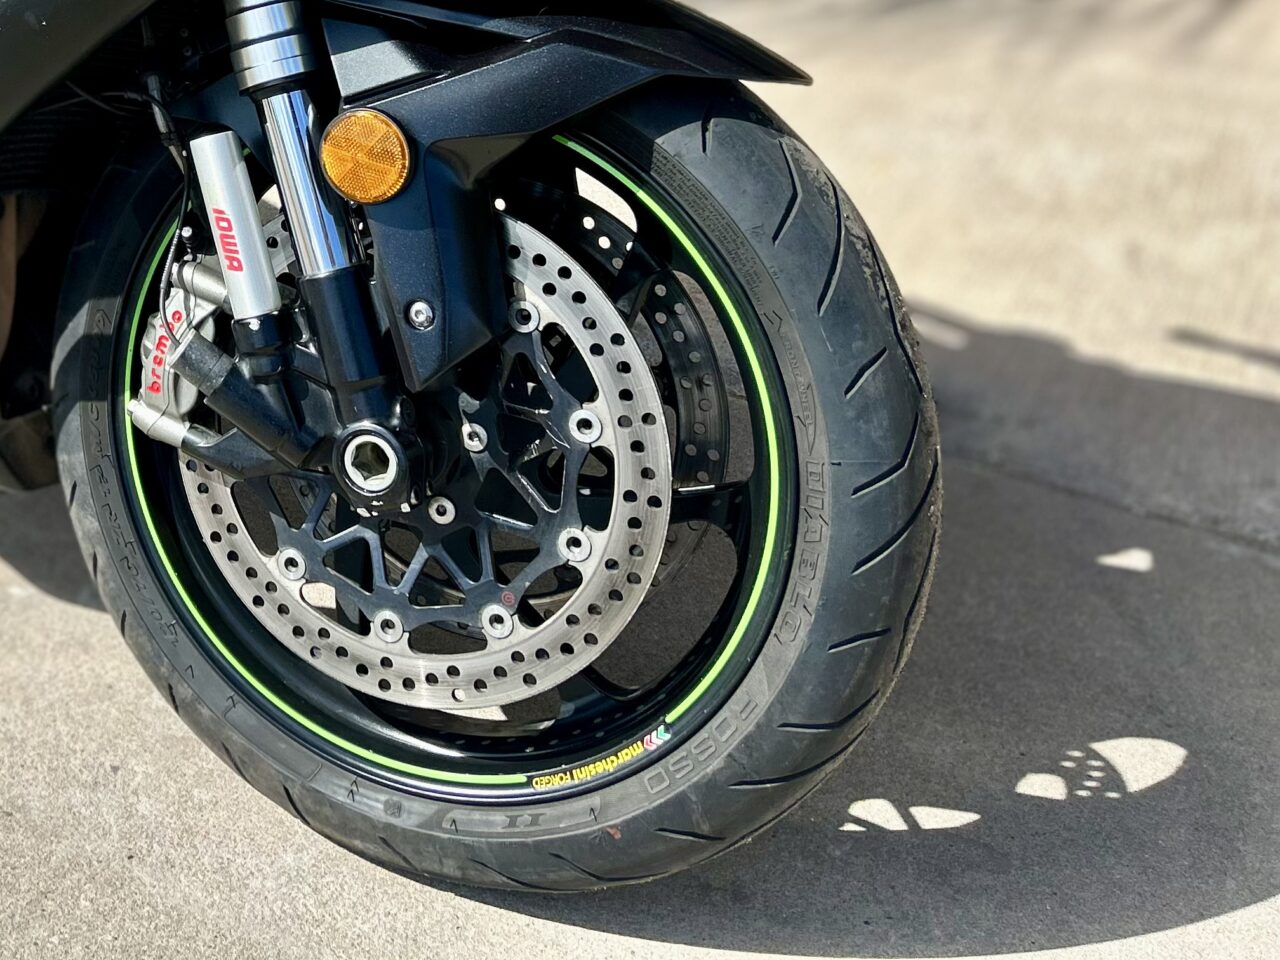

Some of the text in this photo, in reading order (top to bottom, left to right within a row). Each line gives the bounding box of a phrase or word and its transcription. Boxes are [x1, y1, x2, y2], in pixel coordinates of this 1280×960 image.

[777, 458, 827, 644] DIABLO
[531, 740, 644, 791] marchesini FORGED
